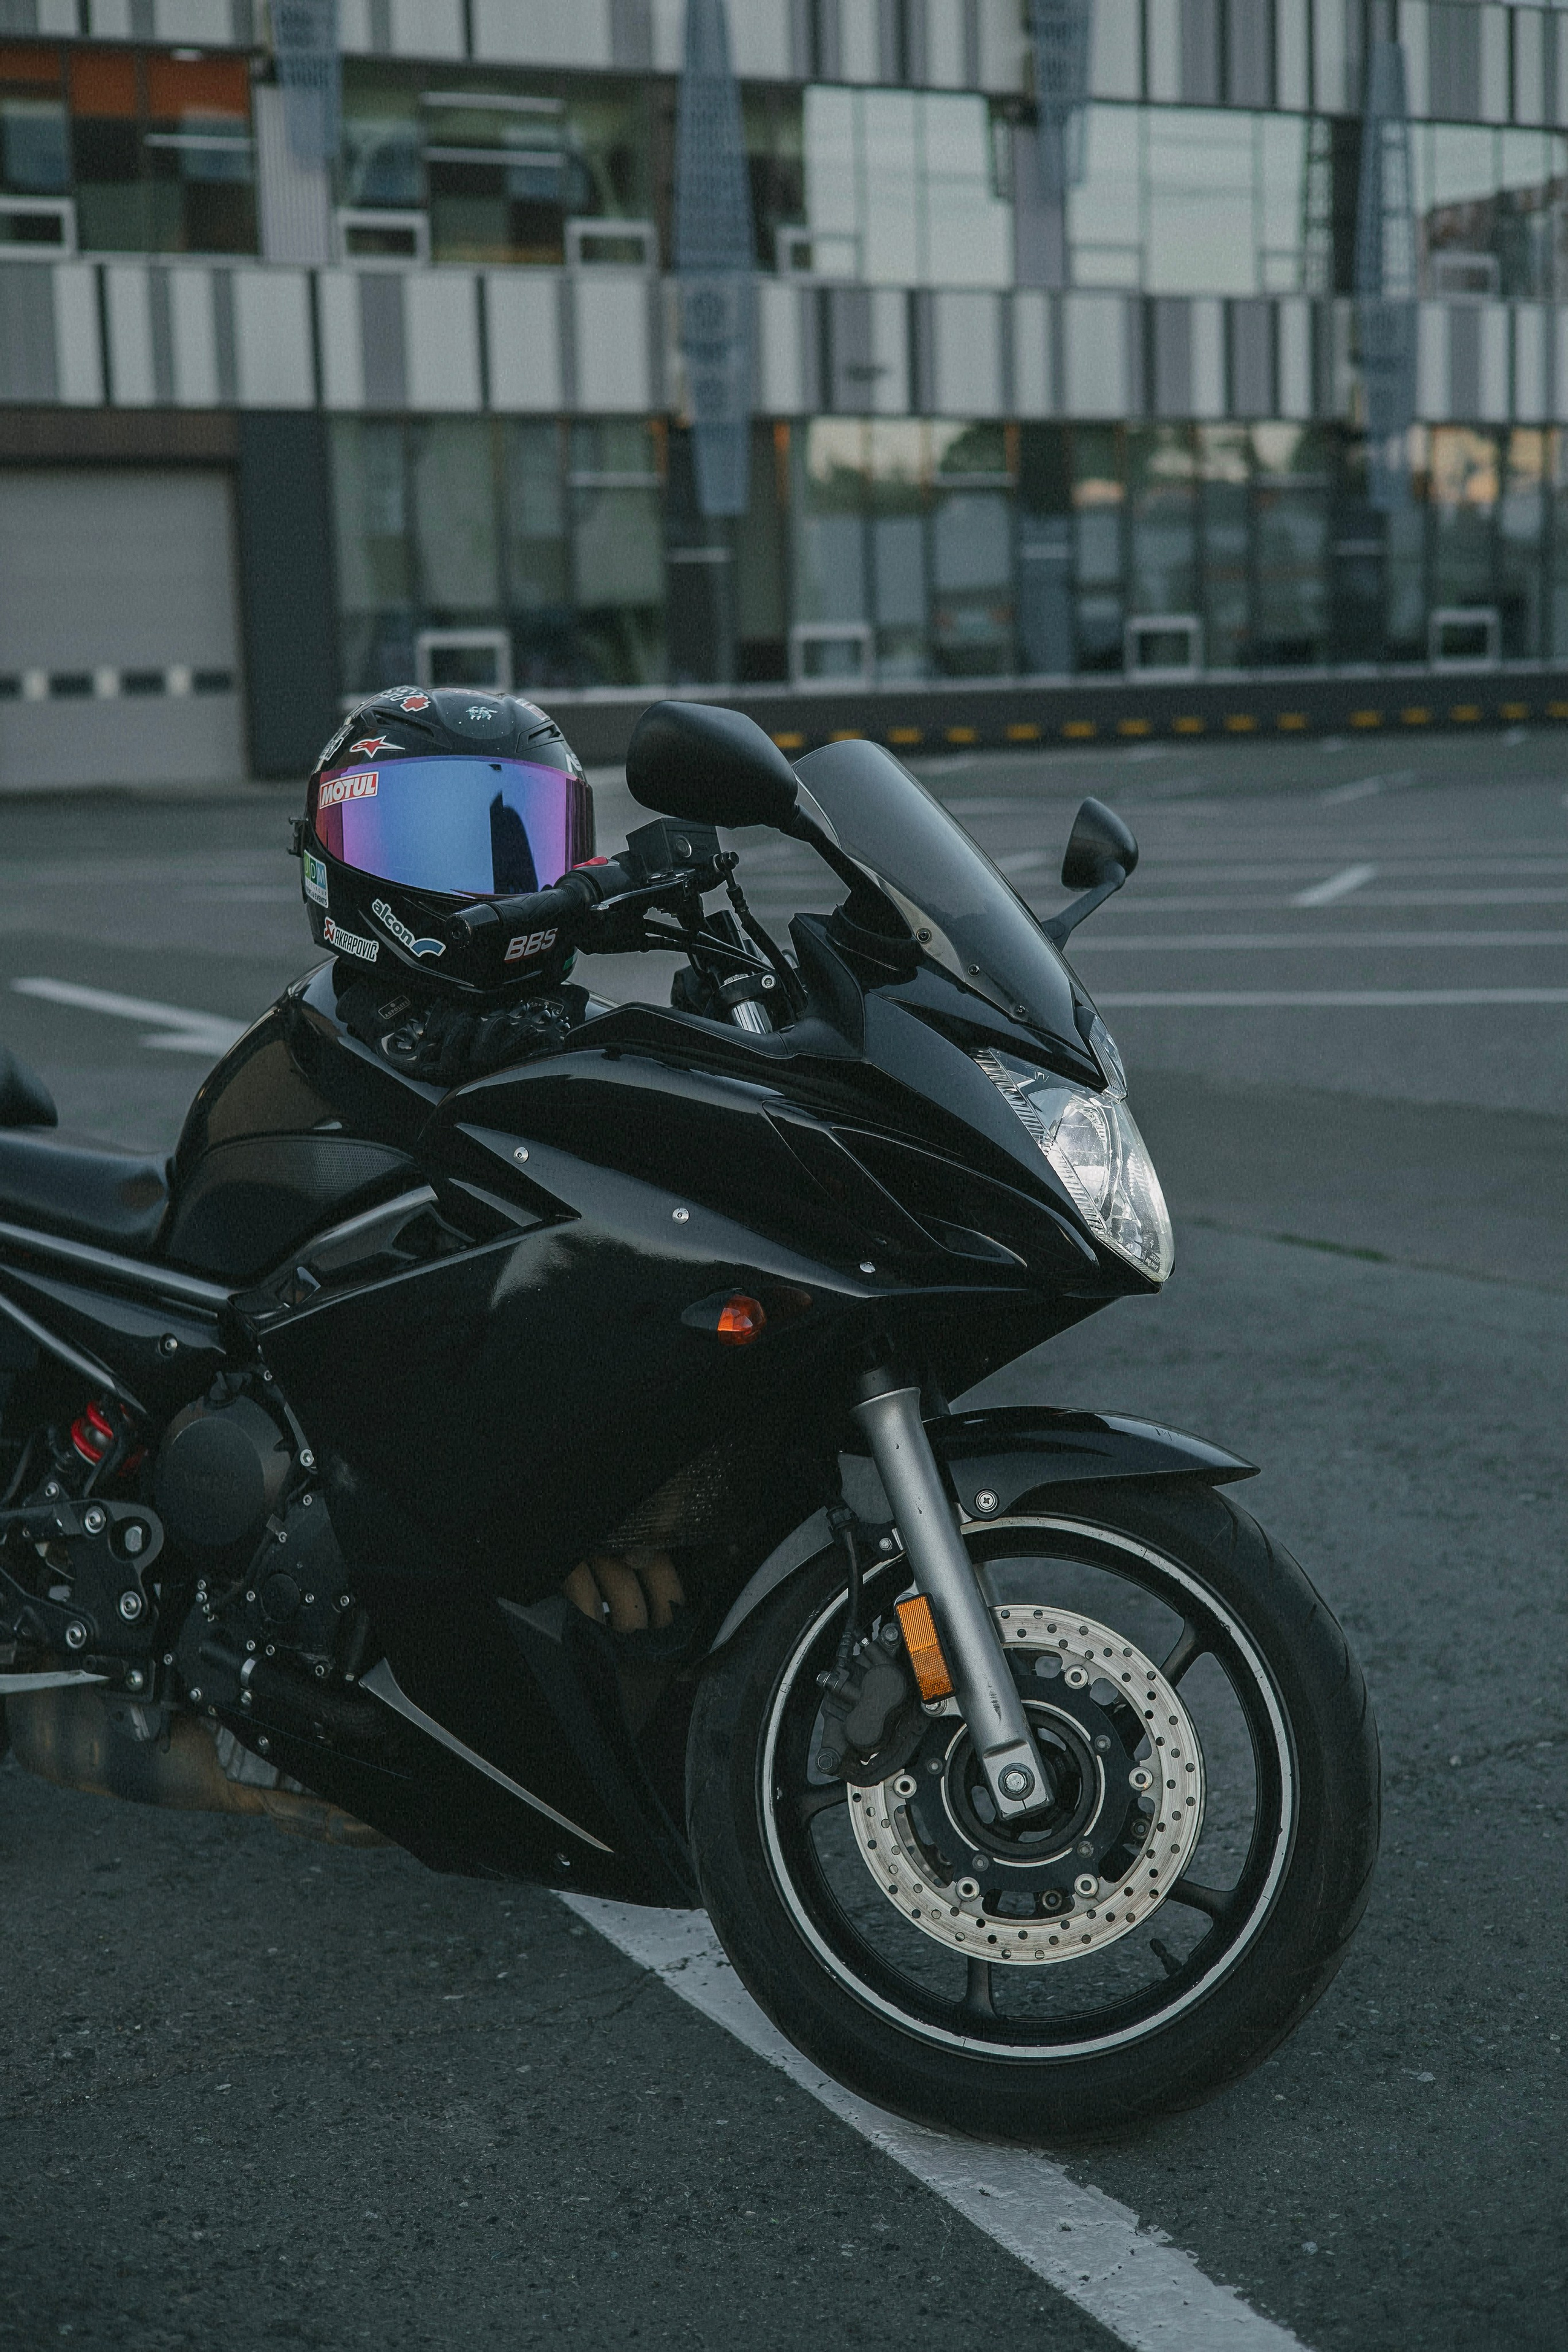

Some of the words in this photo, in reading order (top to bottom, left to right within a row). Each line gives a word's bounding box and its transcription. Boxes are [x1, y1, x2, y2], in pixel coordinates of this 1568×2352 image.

[321, 775, 375, 807] MOTUL
[306, 858, 325, 886] JDM
[315, 893, 327, 906] EVENTS
[374, 901, 413, 946] alcon
[504, 927, 559, 961] BBS
